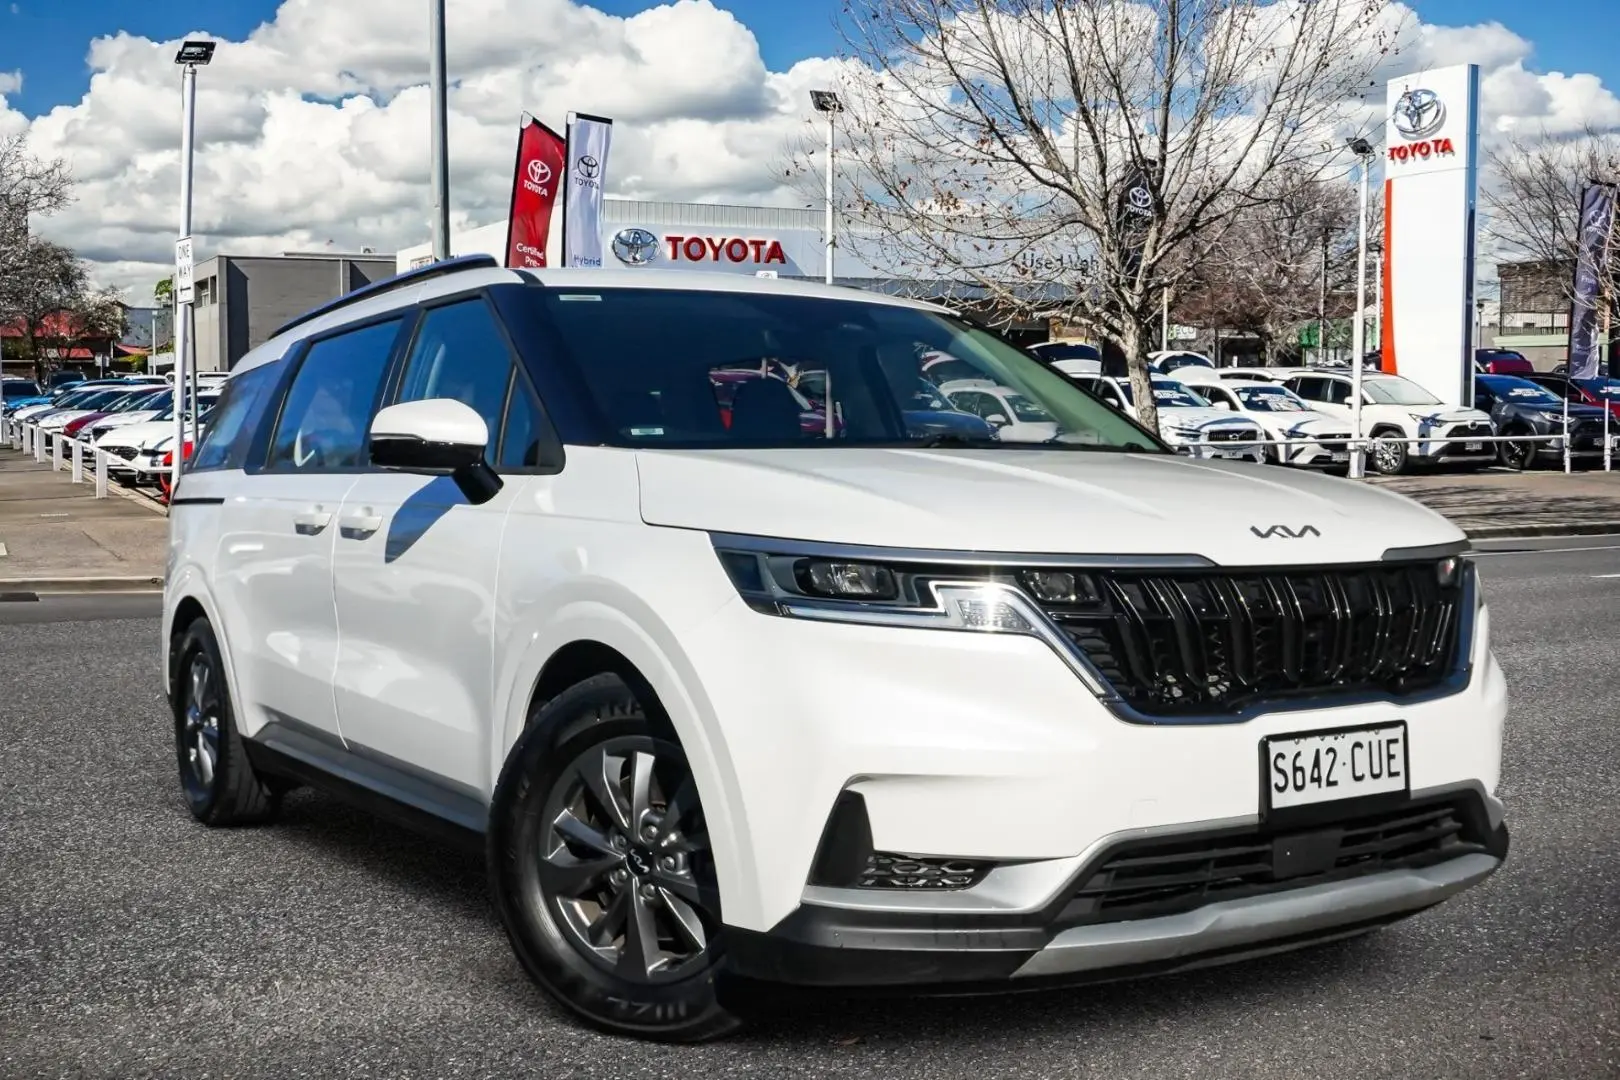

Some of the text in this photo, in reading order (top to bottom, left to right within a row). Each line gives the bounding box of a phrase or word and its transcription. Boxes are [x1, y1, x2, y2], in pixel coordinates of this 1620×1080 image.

[1387, 138, 1454, 161] TOYOTA
[523, 180, 548, 196] TOYOTA
[575, 177, 599, 190] TOYOTA
[1124, 204, 1153, 217] TOYOTA
[178, 243, 190, 260] ONE
[665, 236, 787, 264] TOYOTA
[573, 254, 601, 267] Hybrid
[1022, 252, 1064, 270] Used
[178, 264, 191, 279] WAY
[1250, 525, 1321, 539] KIA
